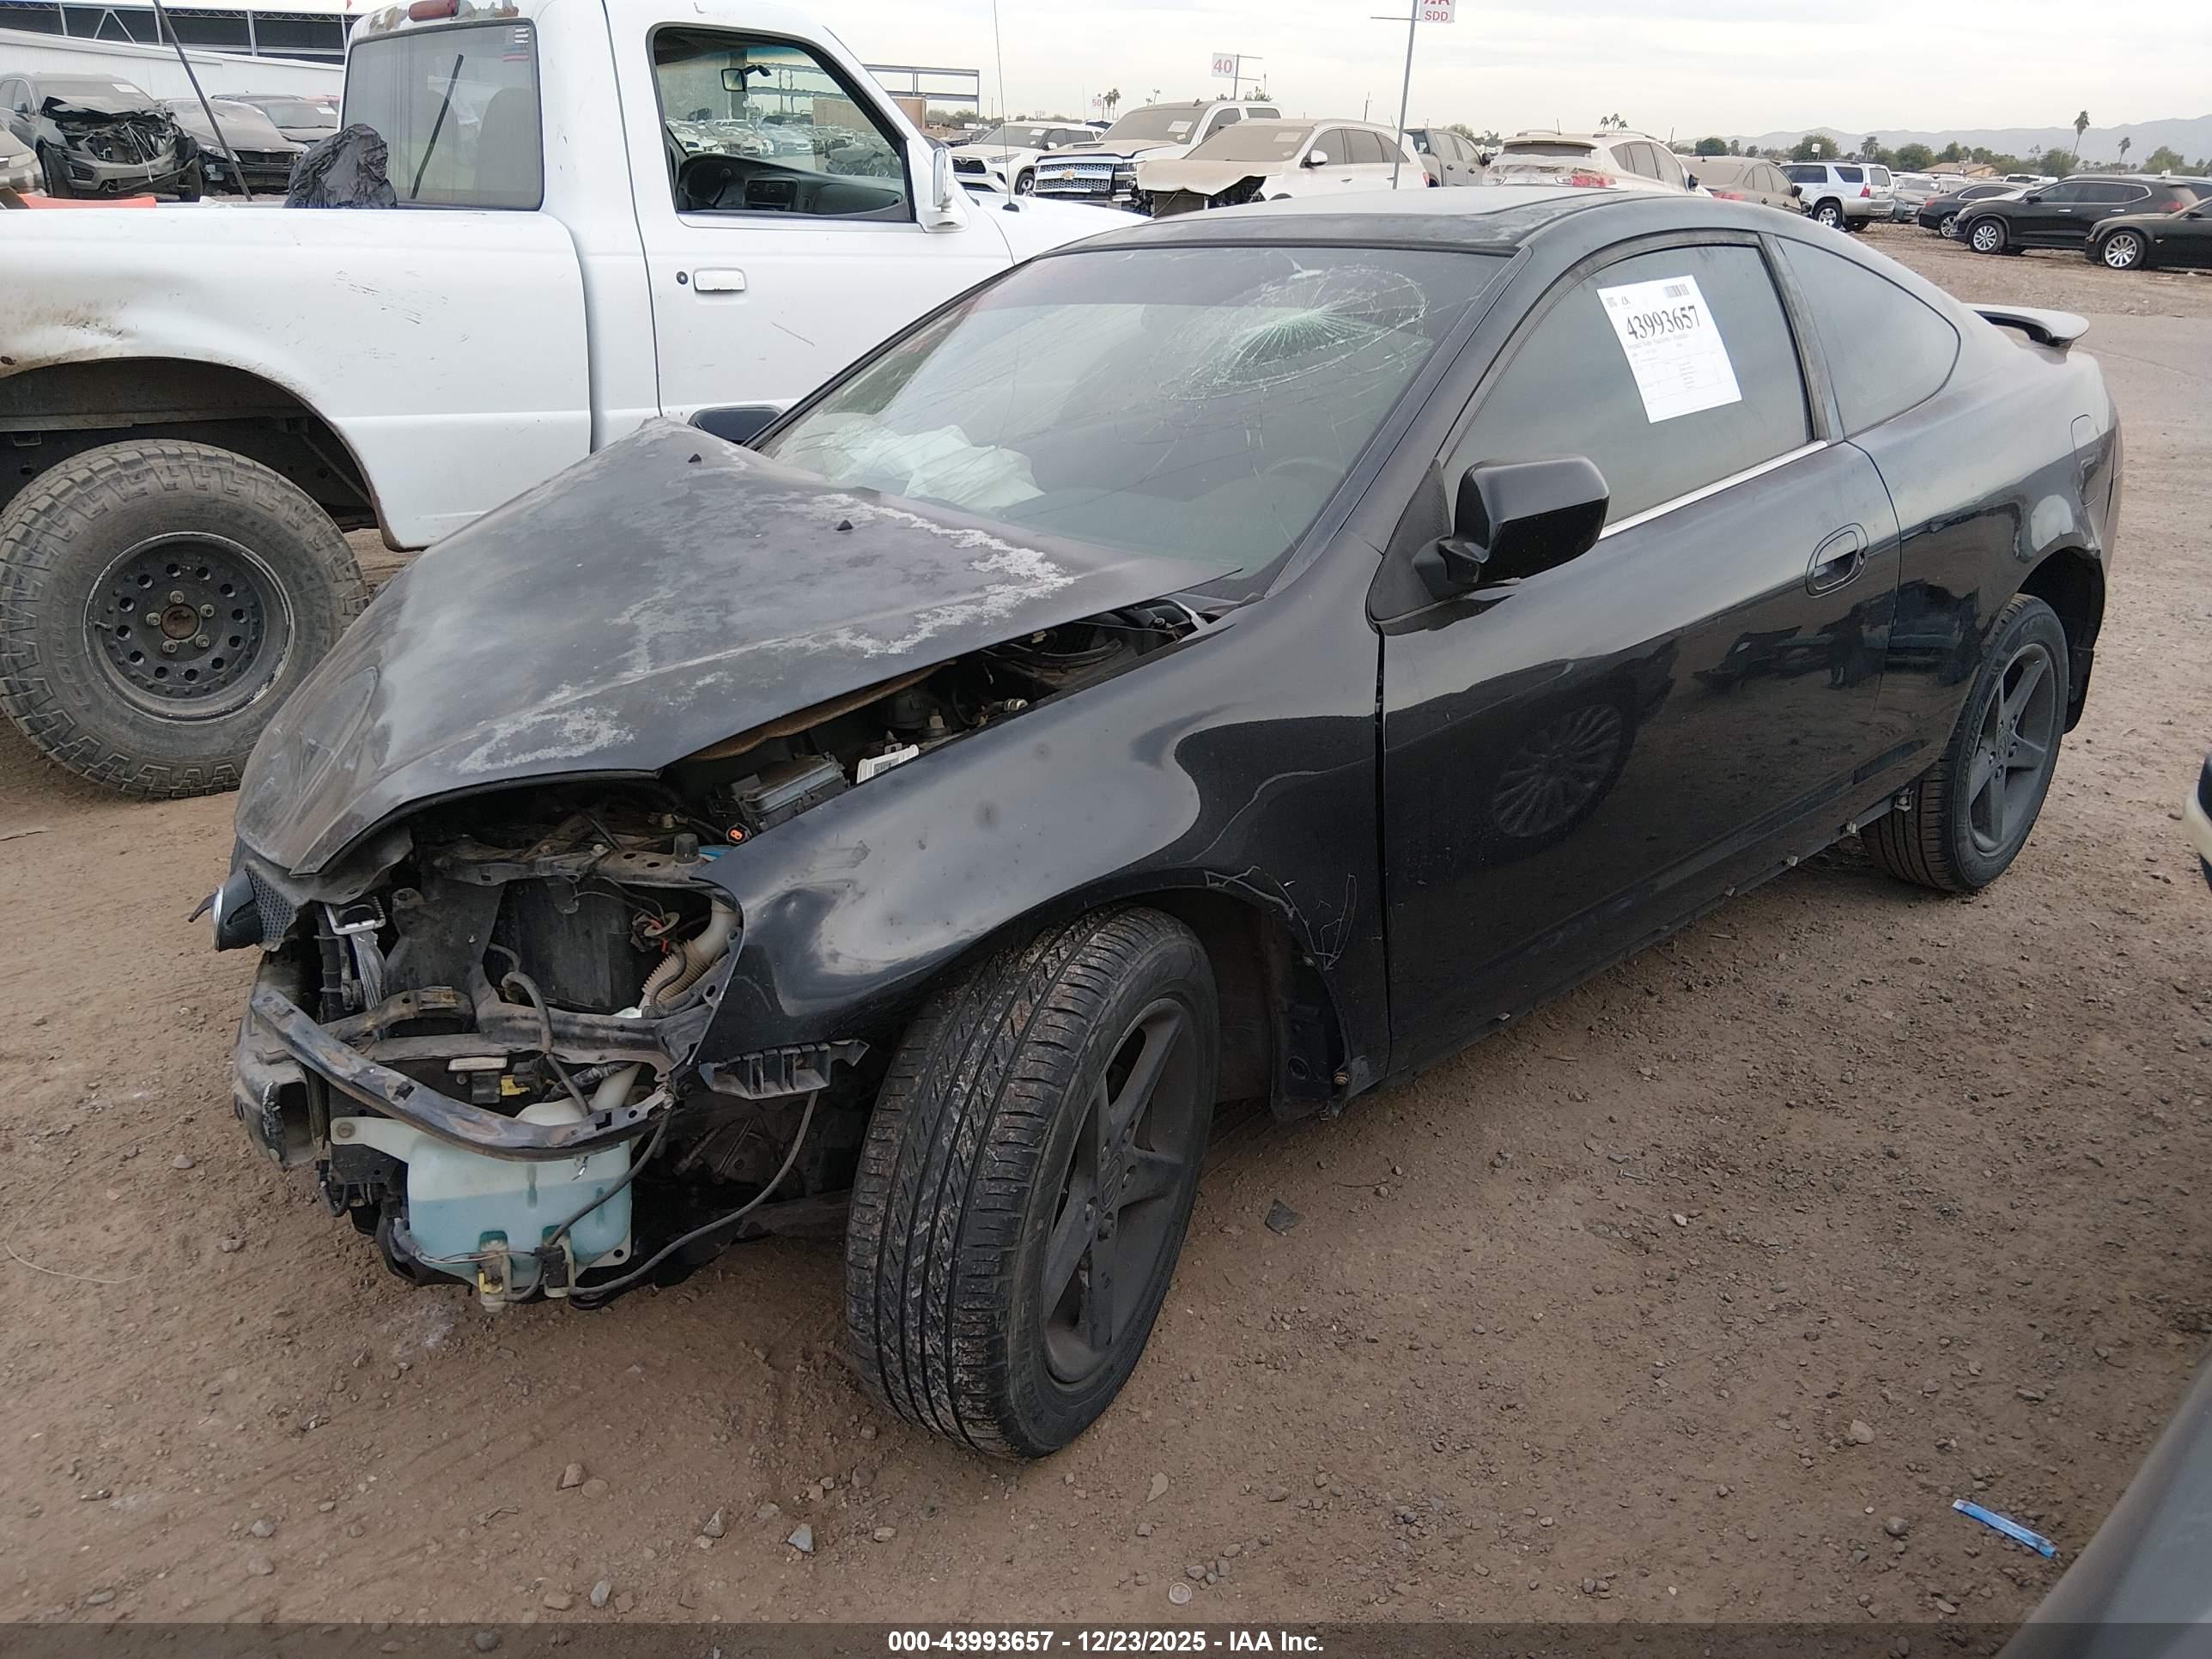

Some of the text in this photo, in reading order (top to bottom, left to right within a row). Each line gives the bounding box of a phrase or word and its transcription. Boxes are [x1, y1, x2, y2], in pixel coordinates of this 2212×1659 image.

[1425, 10, 1449, 21] SDD
[1213, 59, 1232, 73] 40
[1626, 304, 1700, 340] 43993657
